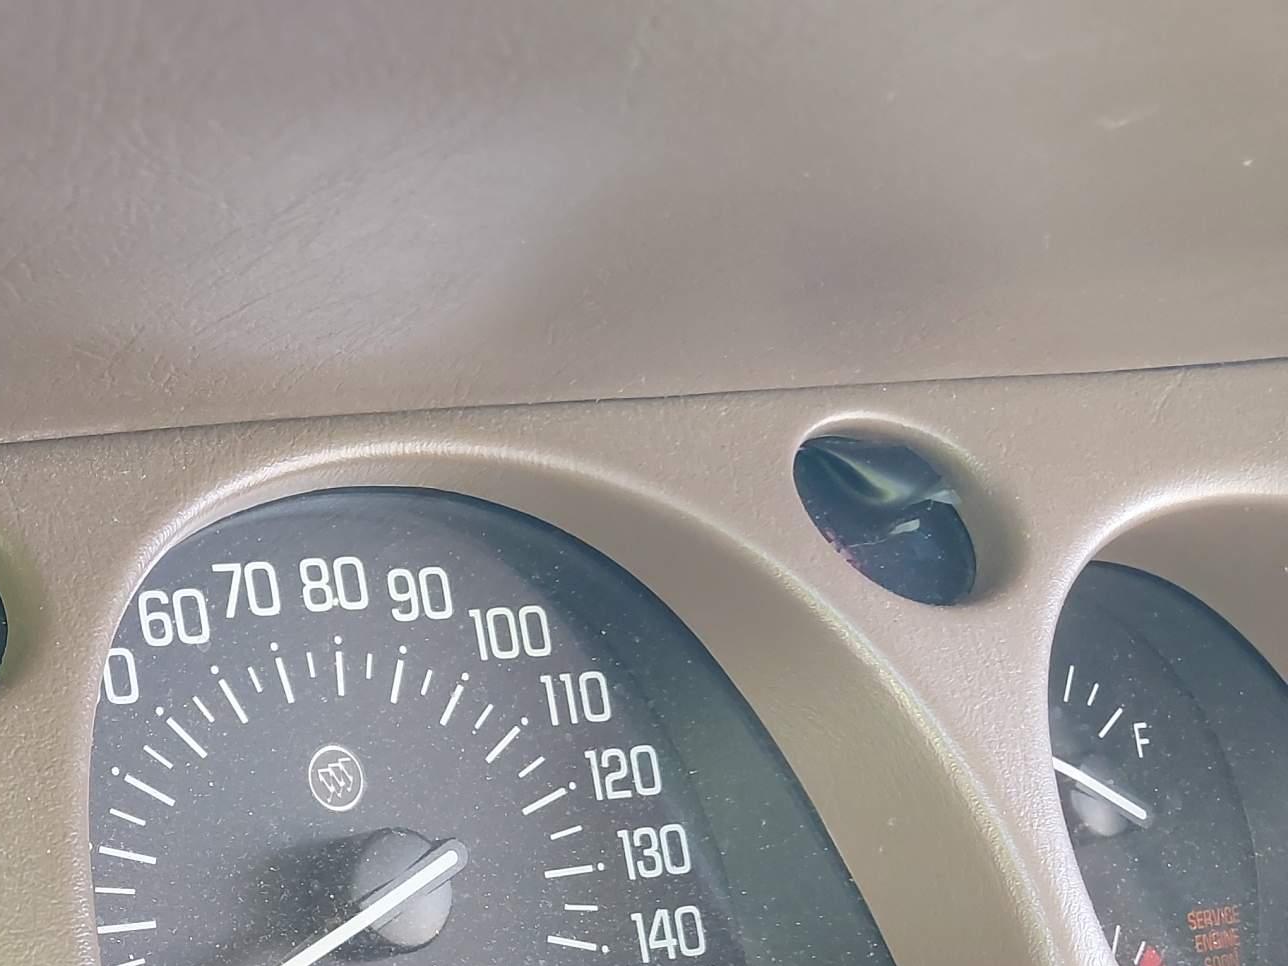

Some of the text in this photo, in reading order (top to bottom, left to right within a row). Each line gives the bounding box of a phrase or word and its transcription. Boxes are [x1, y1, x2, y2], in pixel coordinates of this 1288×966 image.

[212, 561, 281, 618] 70
[299, 556, 369, 612] 80
[387, 566, 454, 622] 90
[138, 588, 210, 647] 60
[469, 605, 552, 660] 100
[540, 671, 612, 727] 110
[1133, 721, 1150, 758] F
[585, 744, 662, 801] 120
[617, 824, 691, 880] 130
[631, 905, 706, 963] 140
[1187, 905, 1241, 931] SERVICE
[1194, 928, 1241, 953] ENGINE
